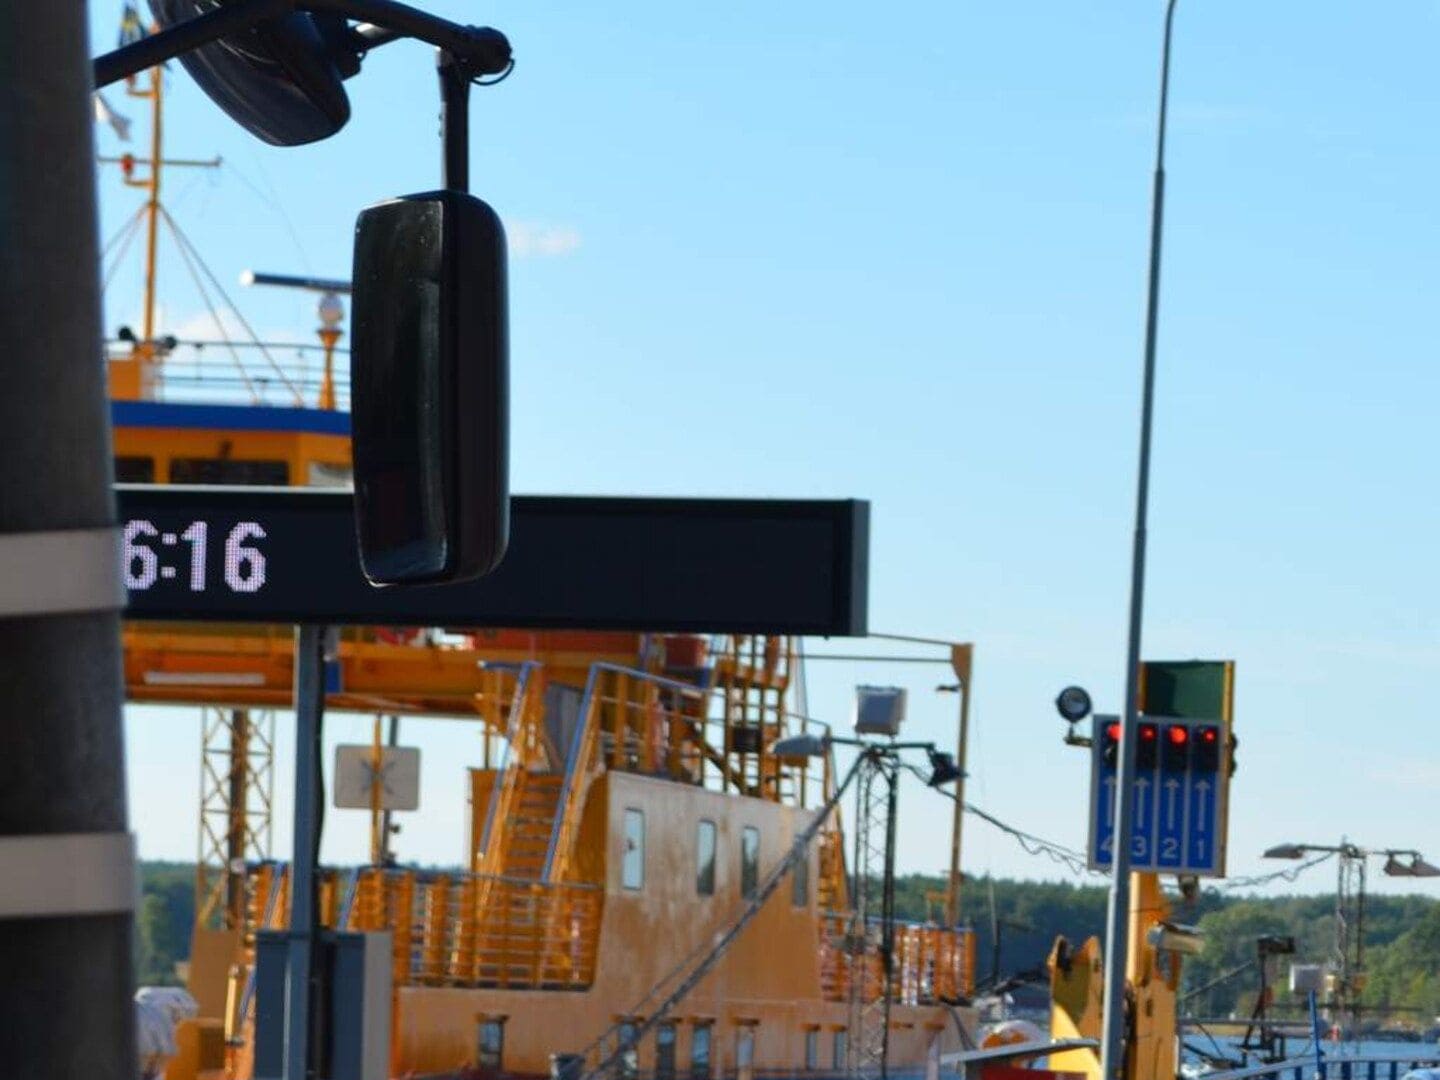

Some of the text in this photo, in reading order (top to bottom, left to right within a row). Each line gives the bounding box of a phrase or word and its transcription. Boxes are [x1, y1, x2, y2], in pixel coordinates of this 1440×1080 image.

[1131, 836, 1147, 857] 3
[1162, 837, 1178, 858] 2
[1197, 840, 1204, 860] 1
